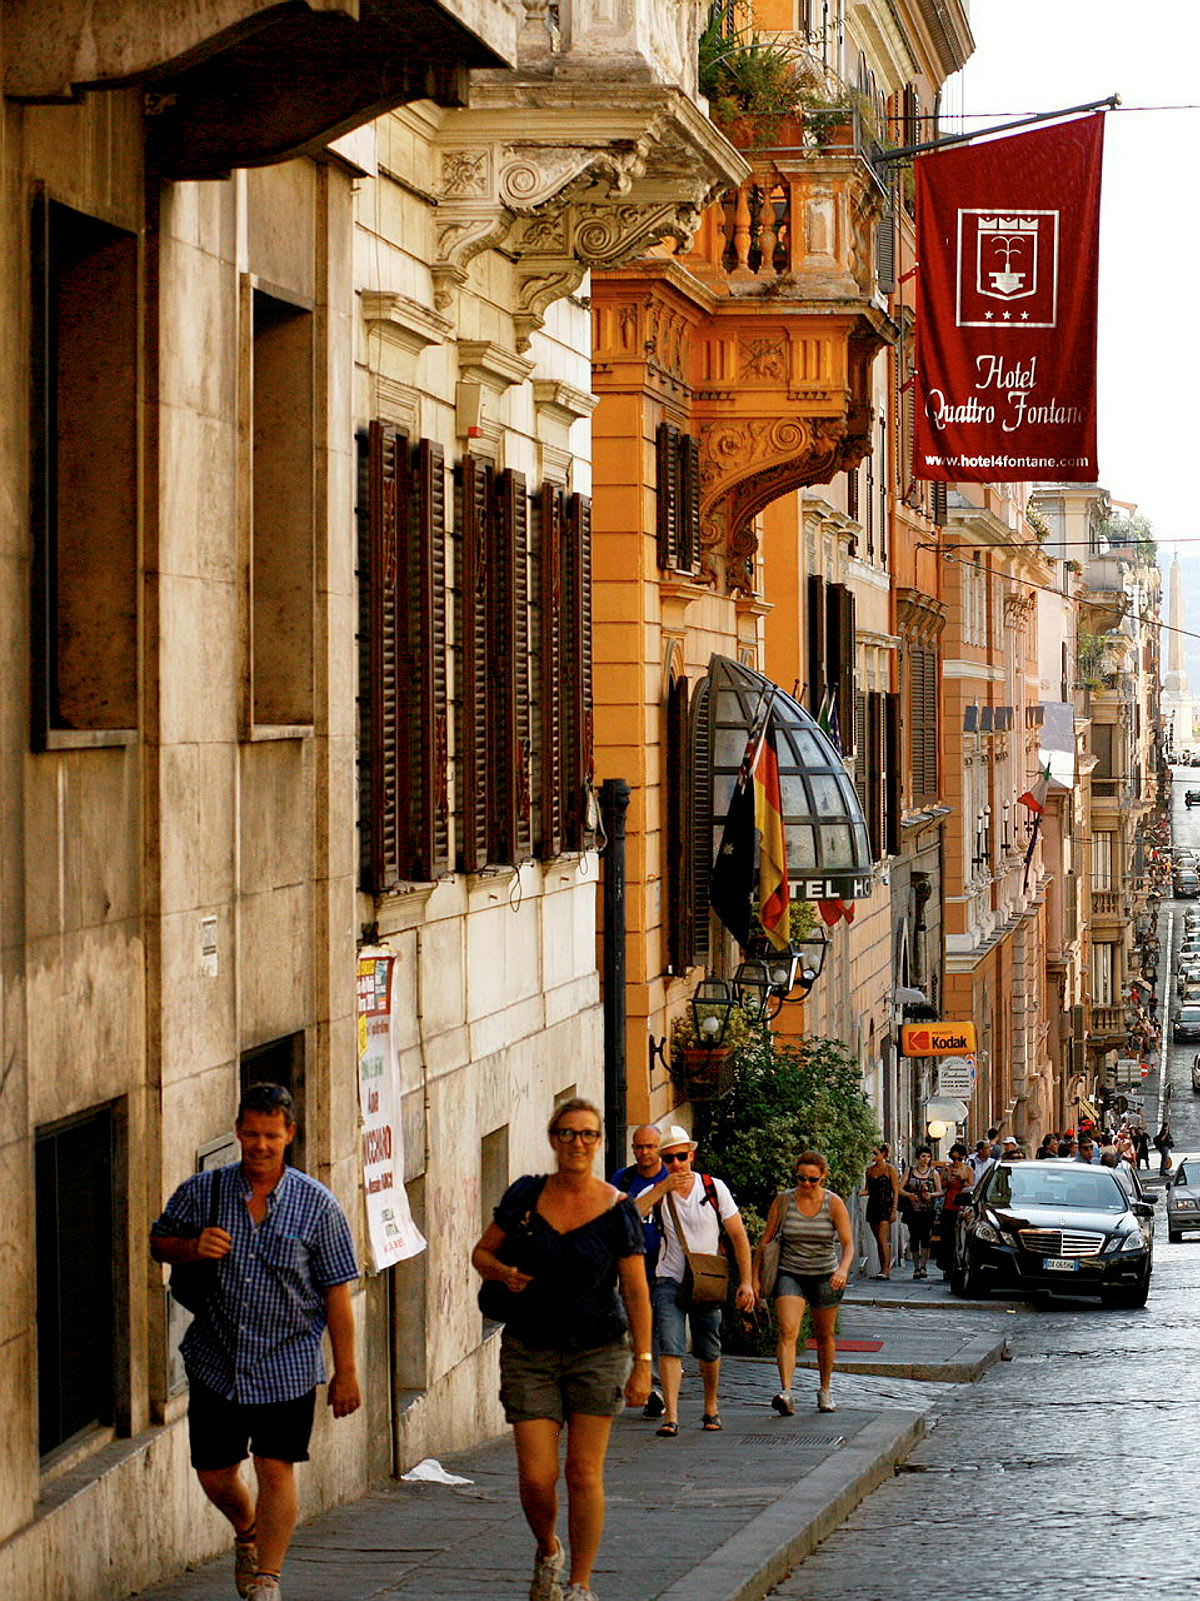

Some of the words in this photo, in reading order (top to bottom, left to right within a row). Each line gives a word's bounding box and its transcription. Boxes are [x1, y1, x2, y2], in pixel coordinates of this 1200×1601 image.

[975, 355, 1037, 389] Hotel
[925, 389, 995, 430] Quattro
[925, 454, 1089, 467] www.hotel4fontane.com
[932, 1035, 967, 1049] Kodak
